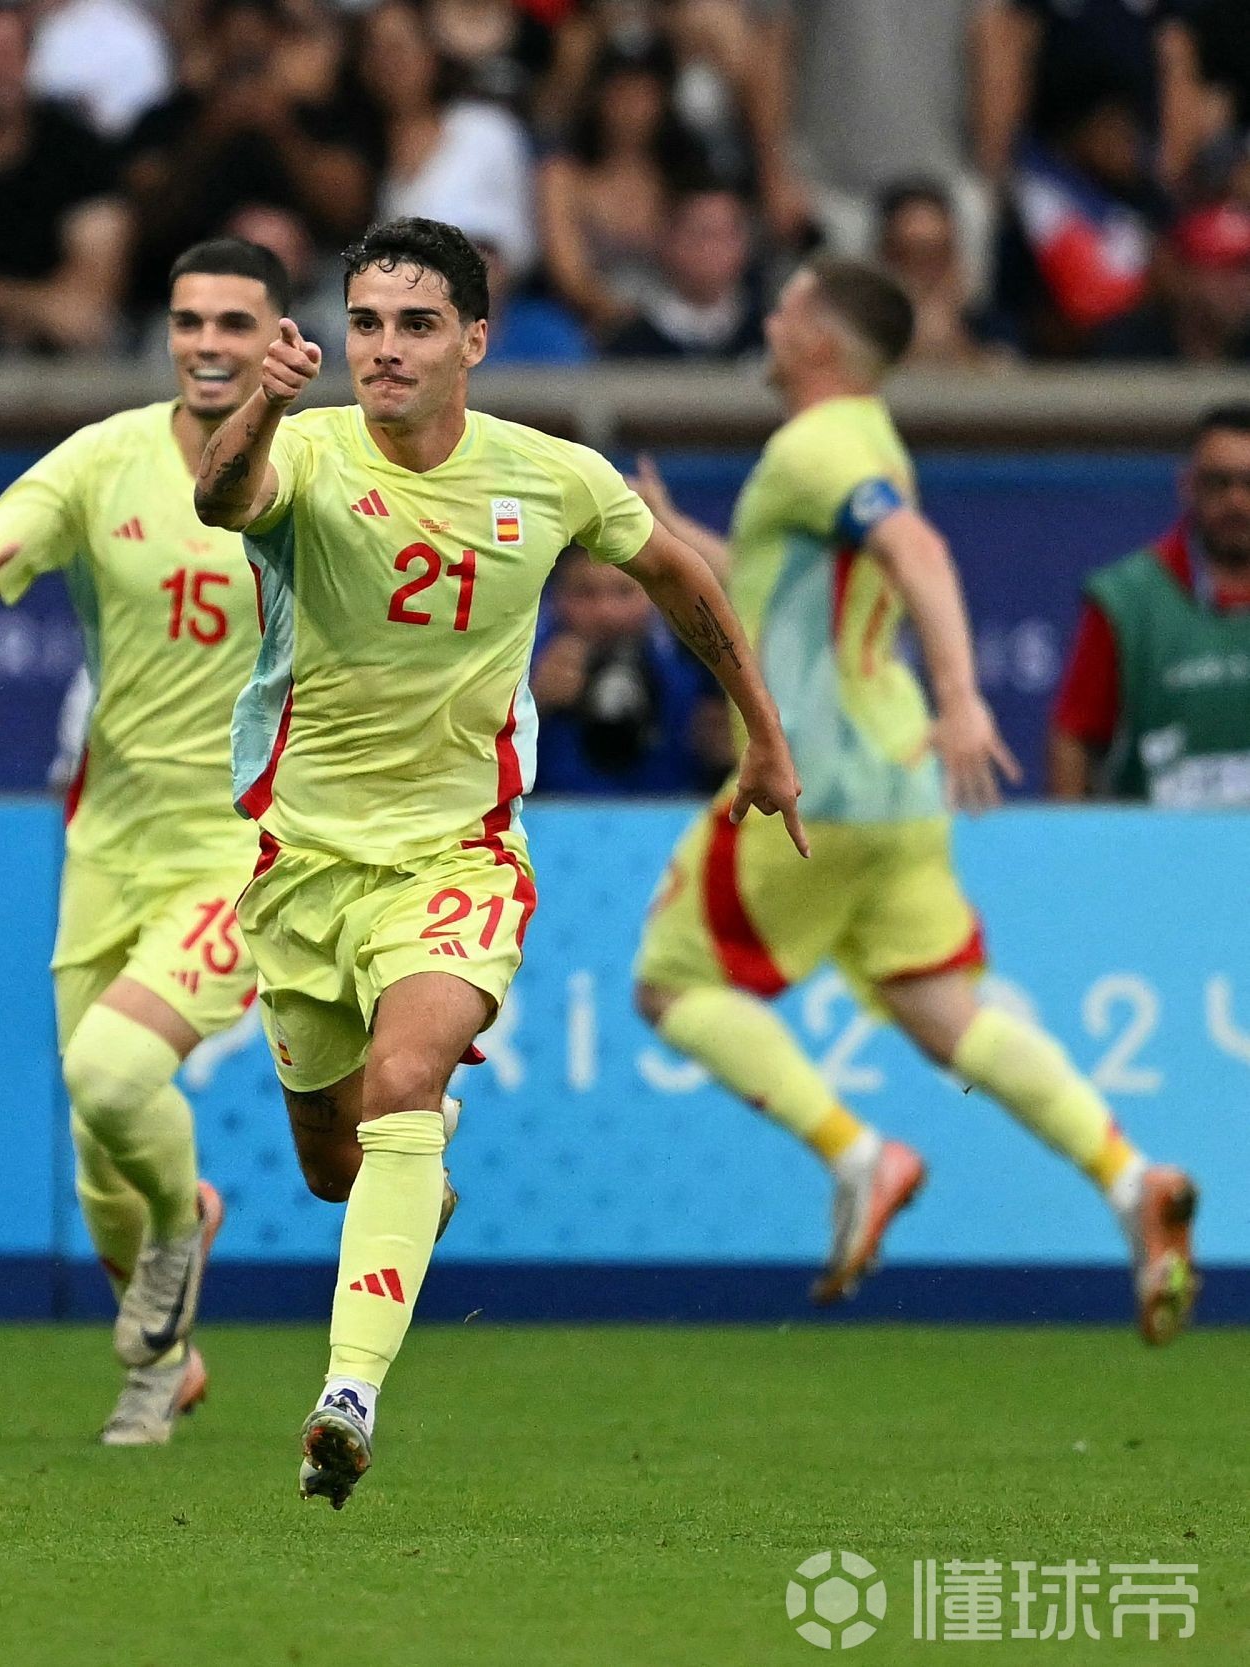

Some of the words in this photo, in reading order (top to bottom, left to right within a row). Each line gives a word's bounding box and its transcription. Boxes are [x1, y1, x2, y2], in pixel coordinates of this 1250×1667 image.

[161, 567, 231, 646] 15
[387, 541, 477, 632] 21
[181, 897, 240, 975] 15
[419, 887, 505, 951] 21
